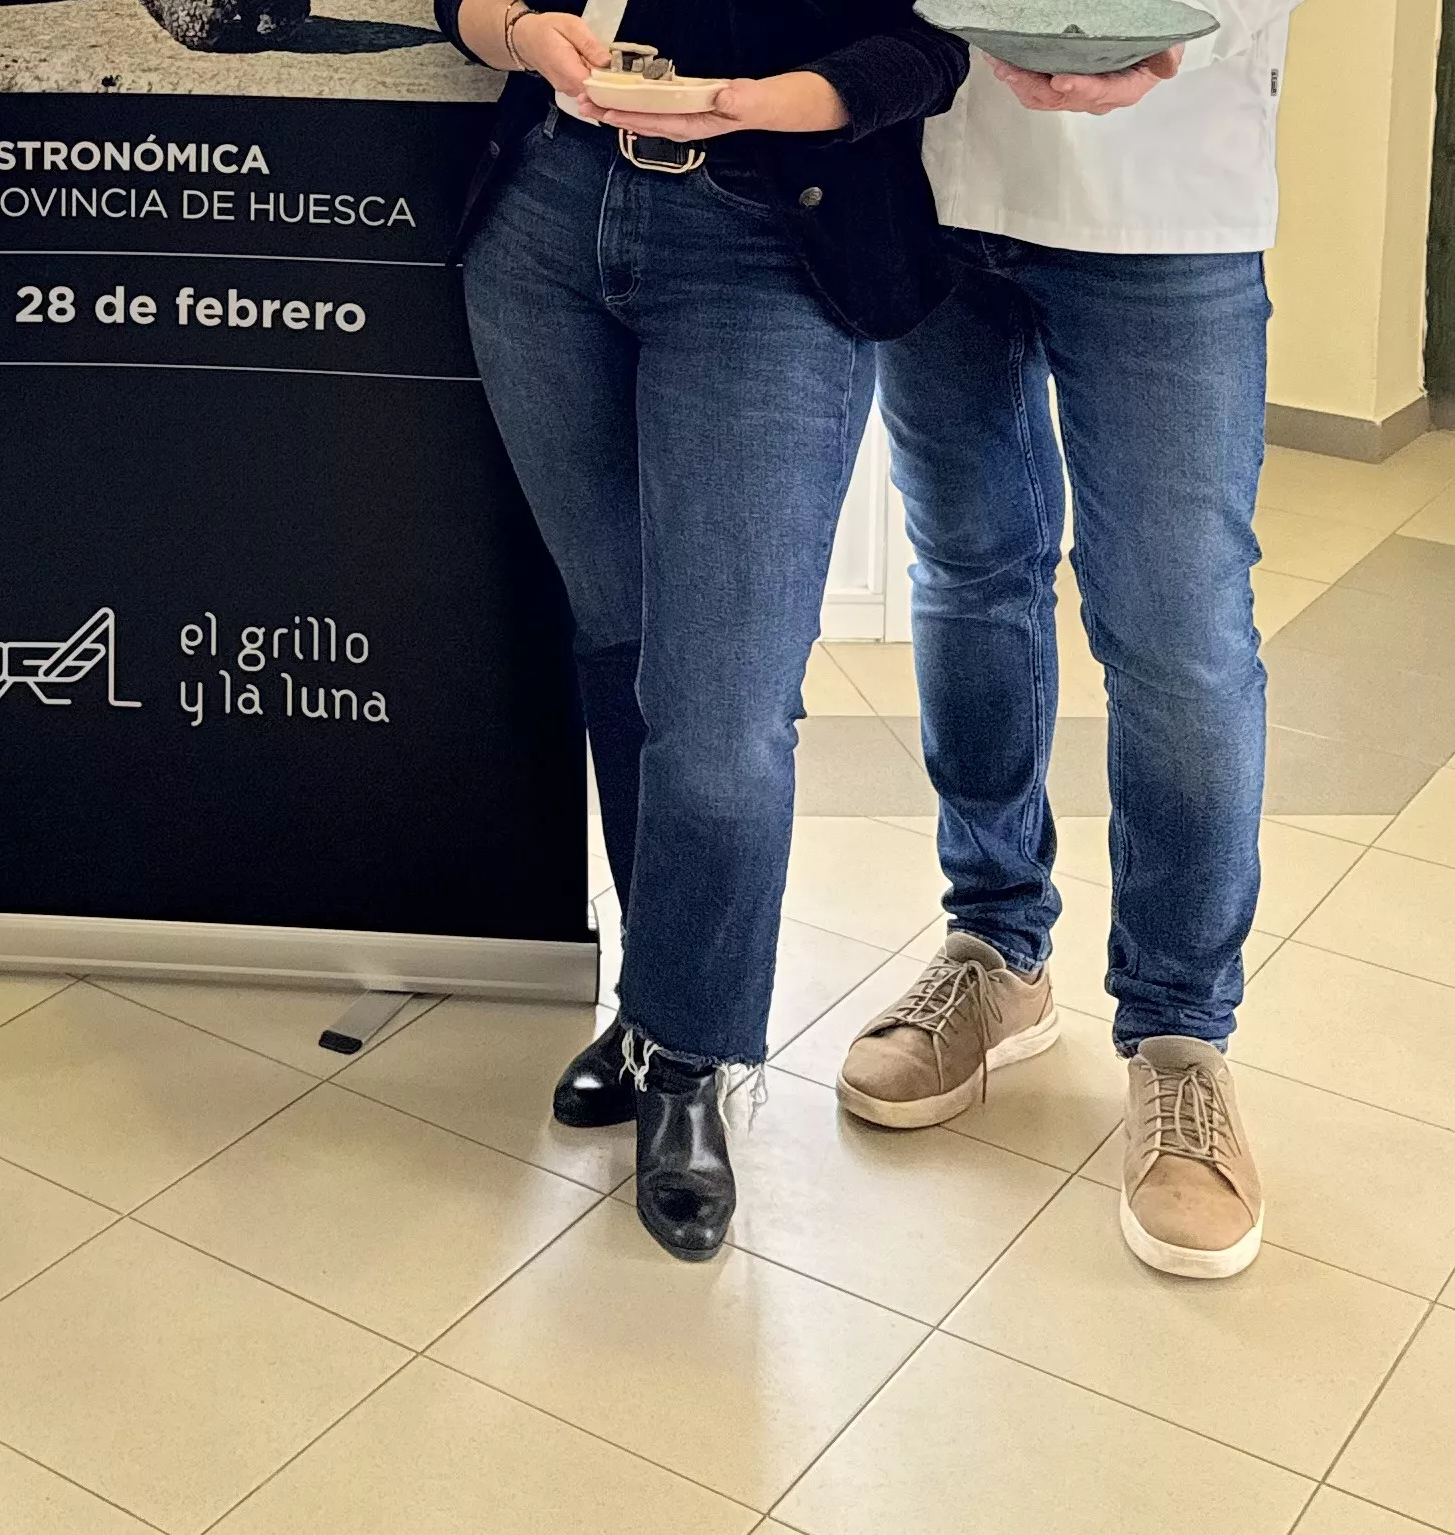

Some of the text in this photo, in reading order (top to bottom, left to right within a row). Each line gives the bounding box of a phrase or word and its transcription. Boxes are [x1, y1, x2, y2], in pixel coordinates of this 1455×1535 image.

[182, 189, 235, 221] DE
[250, 191, 416, 228] HUESCA
[15, 285, 76, 323] 28
[94, 285, 157, 325] de
[175, 286, 366, 333] febrero
[180, 611, 369, 672] el grillo
[180, 667, 390, 727] y la luna
